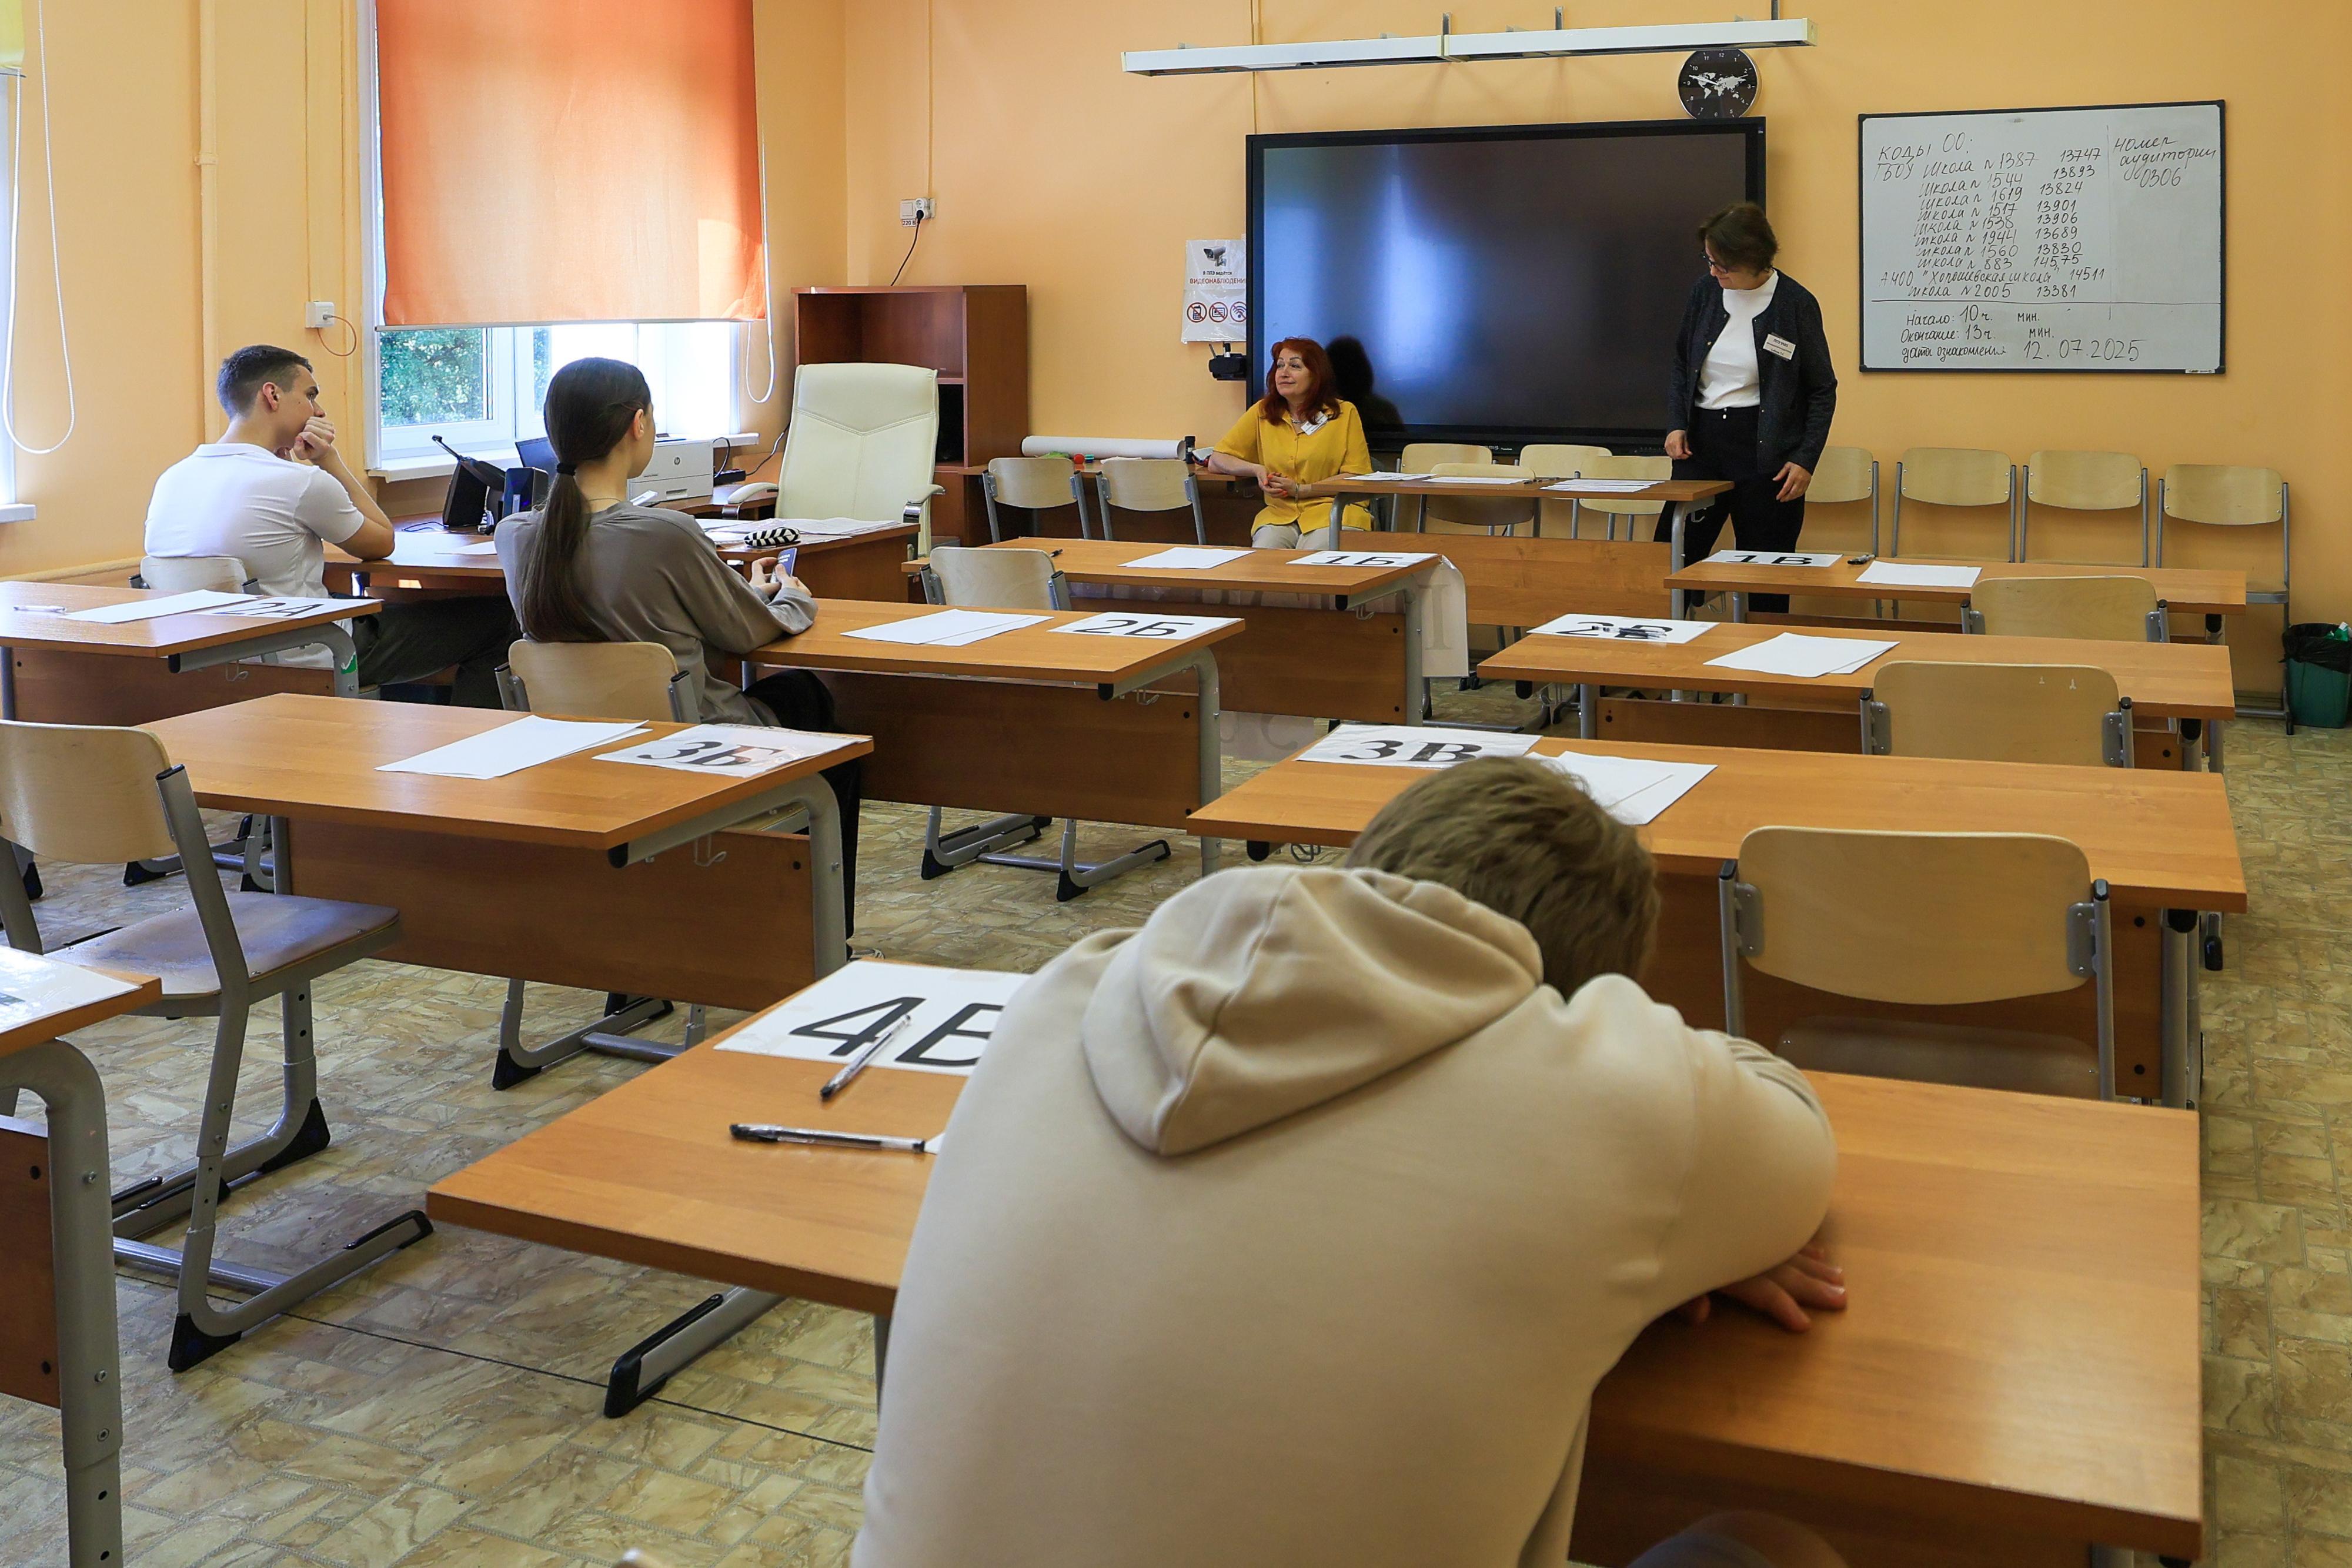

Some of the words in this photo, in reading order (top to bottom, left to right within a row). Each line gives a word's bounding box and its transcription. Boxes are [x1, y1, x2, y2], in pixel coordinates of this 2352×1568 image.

[1873, 163, 1914, 181] ГБОУ
[2000, 152, 2039, 169] 1387
[2060, 148, 2101, 162] 13747
[1987, 172, 2023, 188] 1544
[2053, 165, 2094, 179] 13893
[2140, 168, 2181, 188] 0306
[1992, 186, 2023, 203] 1619
[2040, 181, 2083, 196] 13824
[1989, 202, 2017, 216] 1517
[2037, 200, 2077, 213] 13901
[1982, 215, 2014, 229] 1538
[2037, 212, 2078, 225] 13906
[1982, 229, 2017, 245] 1944
[2035, 226, 2077, 239] 13689
[1981, 245, 2019, 258] 1560
[2038, 241, 2082, 255] 13830
[1984, 258, 2013, 270] 883
[2070, 267, 2105, 280] 14511
[1975, 283, 2014, 297] 2005
[2037, 285, 2076, 297] 13381
[1907, 314, 1955, 326] Начало:
[1901, 329, 1959, 343] Окончание:
